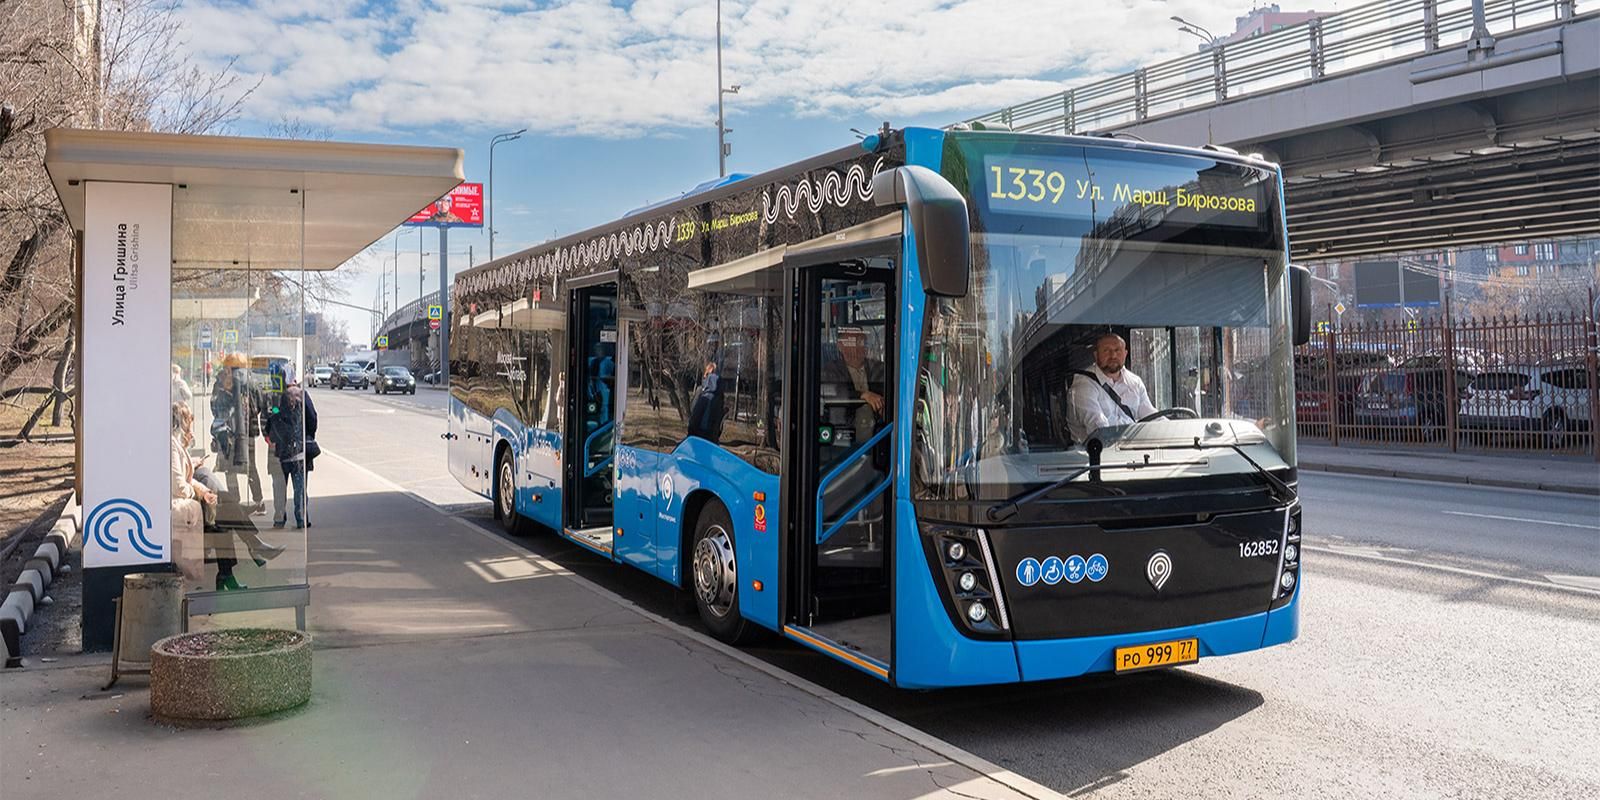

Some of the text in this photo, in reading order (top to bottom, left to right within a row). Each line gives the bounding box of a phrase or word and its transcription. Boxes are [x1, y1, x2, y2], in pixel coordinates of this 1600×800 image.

[991, 166, 1255, 213] 1339 Ул. Марш. Бирюзова
[676, 222, 695, 242] 1339
[729, 211, 758, 226] Бирюзова
[112, 223, 128, 326] Улица Гришина
[129, 223, 140, 290] Ulitsa Grishina
[1239, 539, 1279, 558] 162852
[1146, 645, 1172, 664] 999
[1180, 641, 1193, 655] 77
